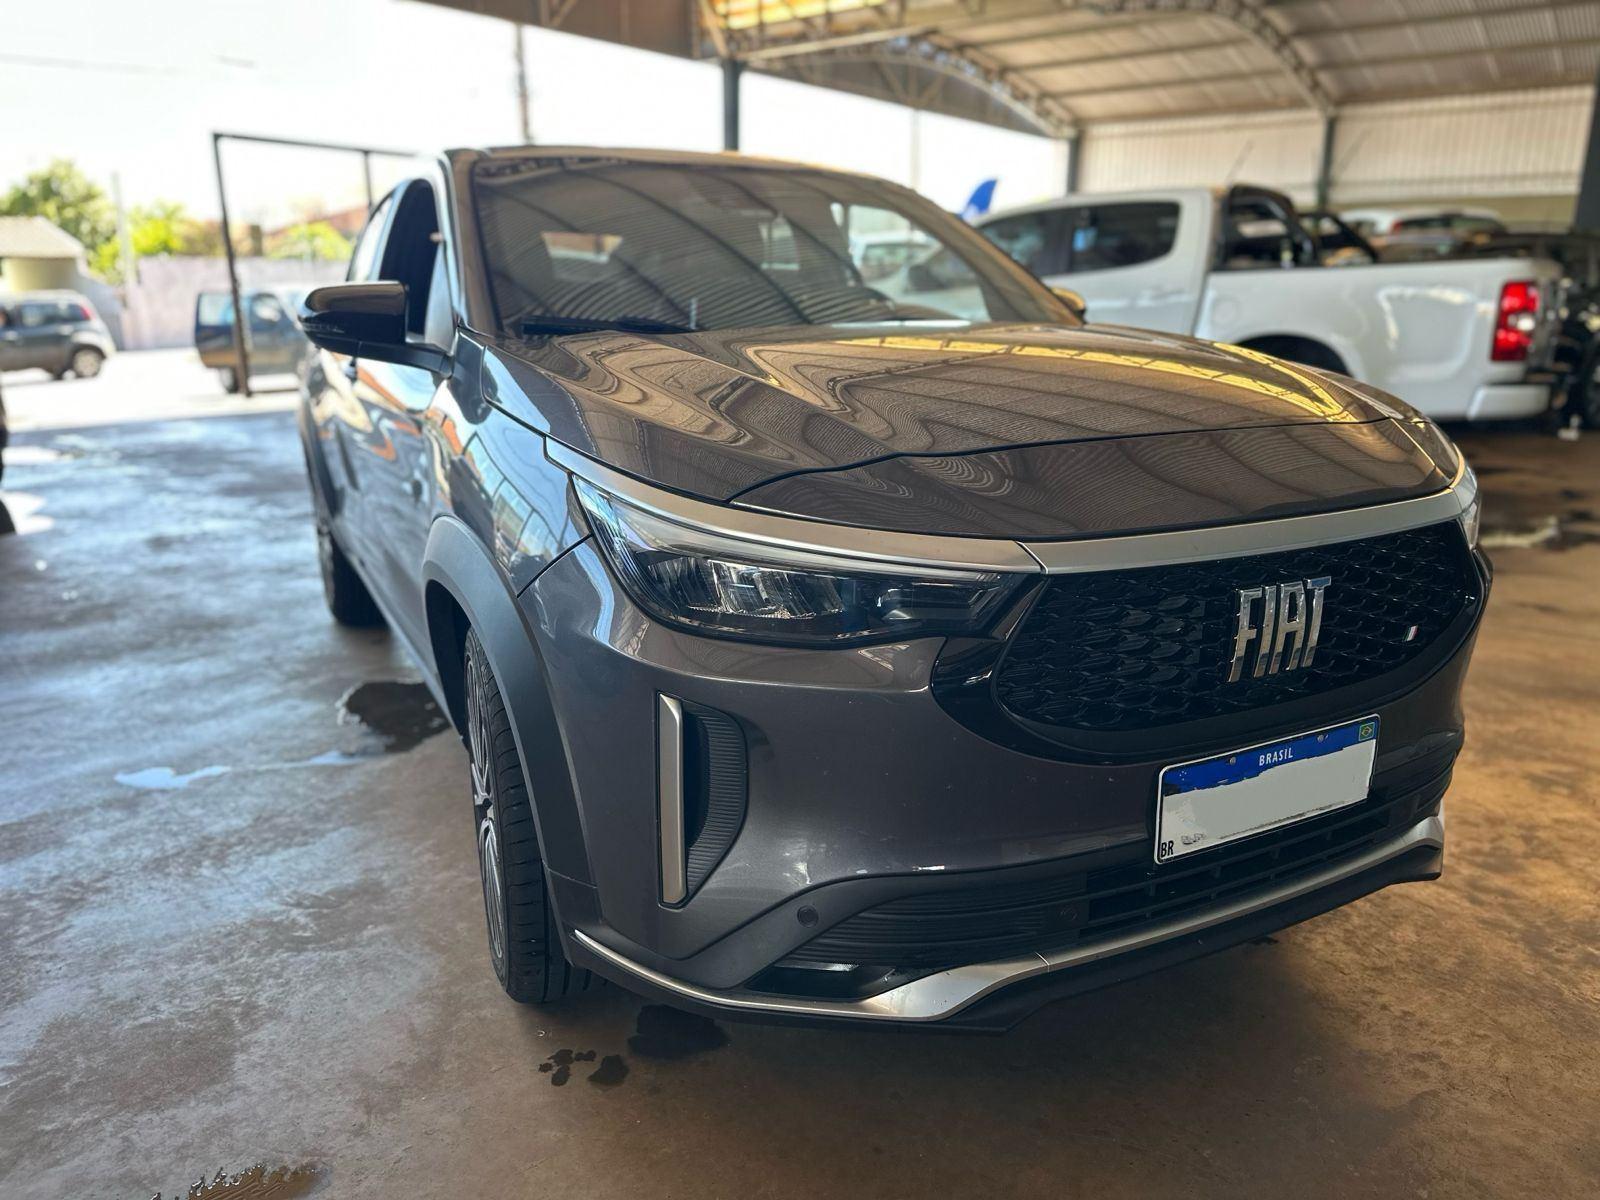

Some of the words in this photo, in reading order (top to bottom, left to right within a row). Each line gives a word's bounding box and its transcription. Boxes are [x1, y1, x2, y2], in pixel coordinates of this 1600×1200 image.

[1227, 576, 1332, 682] FIAT
[1258, 748, 1294, 766] BRASIL
[1160, 840, 1175, 858] BR
